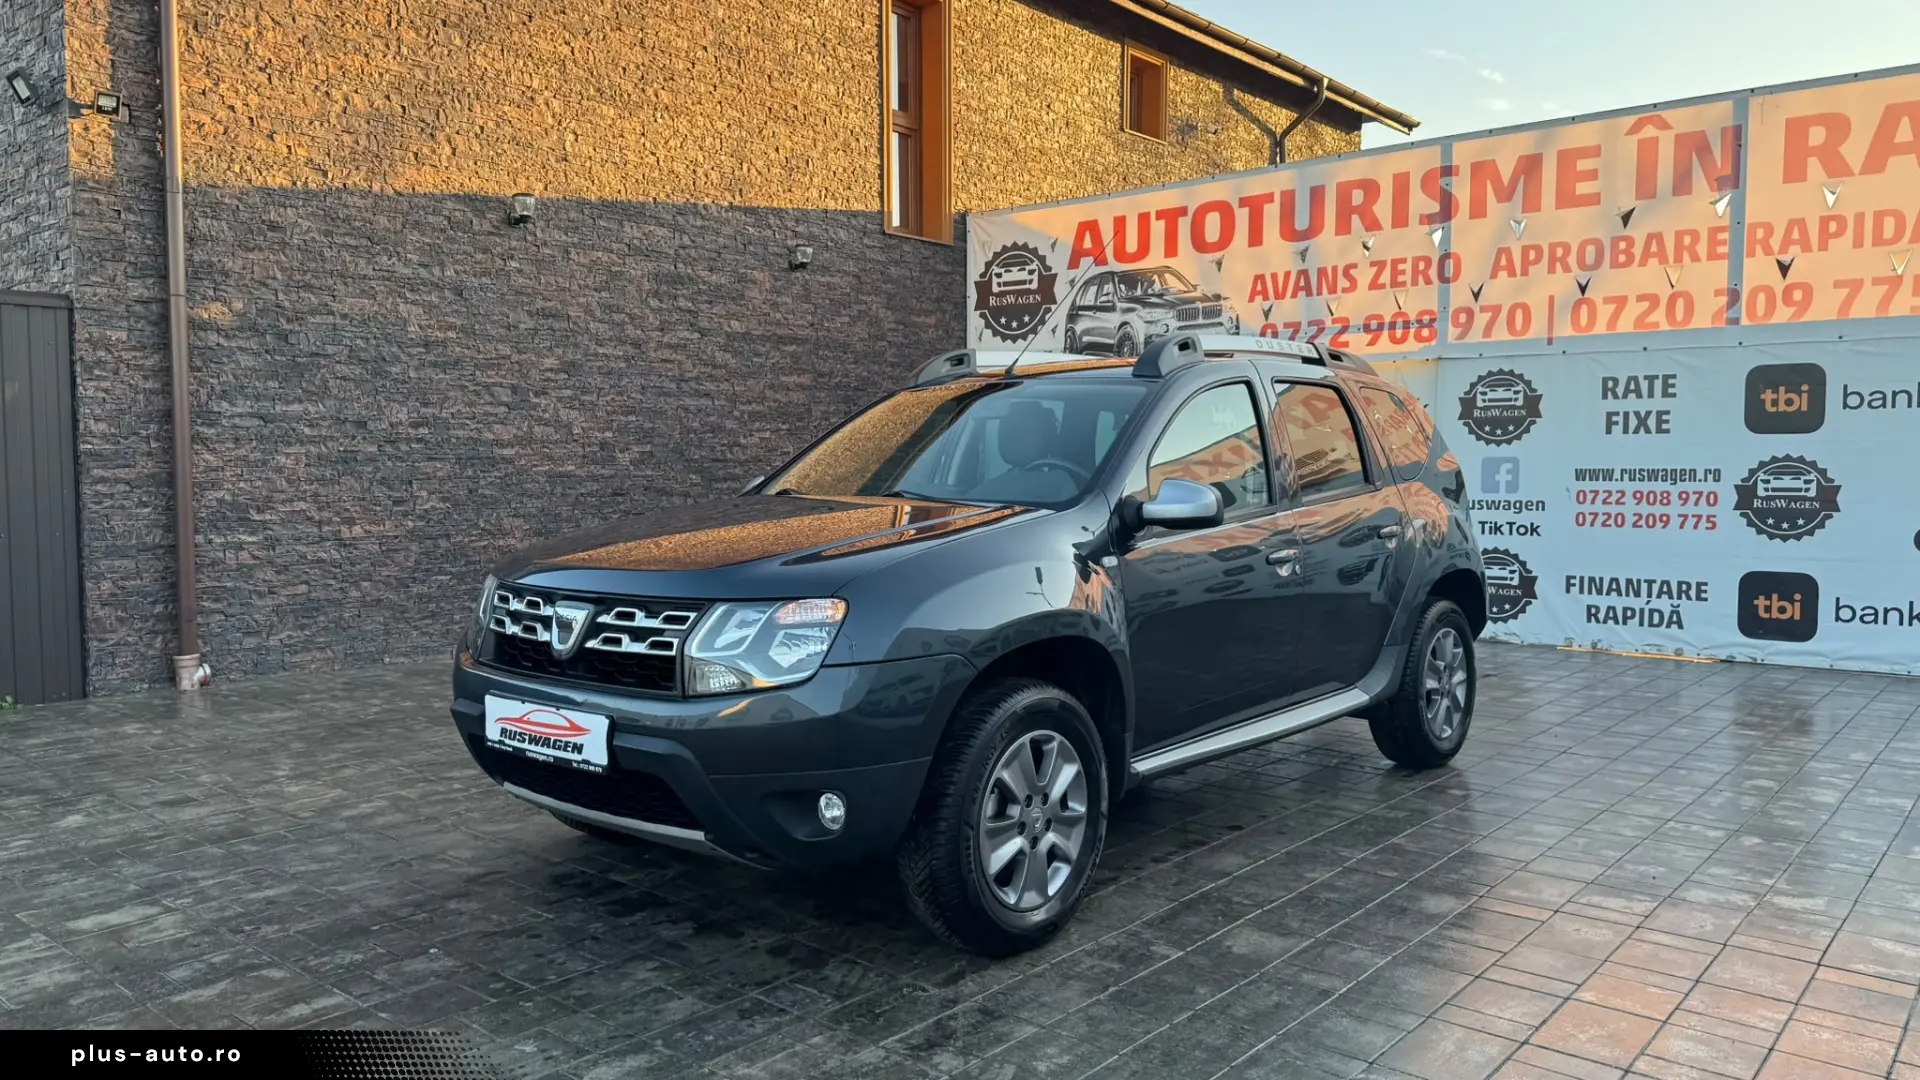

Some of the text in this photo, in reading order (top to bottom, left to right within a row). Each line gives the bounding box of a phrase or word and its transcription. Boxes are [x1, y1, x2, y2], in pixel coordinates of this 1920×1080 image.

[1067, 144, 1602, 270] AUTOTURISME
[1624, 113, 1743, 201] ÎN
[1247, 265, 1358, 304] AVANS
[1368, 251, 1462, 291] ZERO
[1489, 225, 1729, 280] APROBARE
[1363, 308, 1438, 347] 908
[1450, 301, 1532, 341] 970
[1570, 290, 1695, 335] 0720
[1711, 280, 1814, 327] 209
[1256, 339, 1317, 356] DUSTER
[1601, 373, 1678, 400] RATE
[1760, 381, 1920, 413] tbi ban
[1605, 409, 1672, 435] FIXE
[1574, 467, 1722, 485] www.ruswagen.ro
[1575, 489, 1719, 507] 0722 908 970
[1478, 520, 1542, 537] TikTok
[1574, 511, 1718, 531] 0720 209 775
[1753, 592, 1802, 621] tbi
[499, 726, 585, 756] RUSWAGEN
